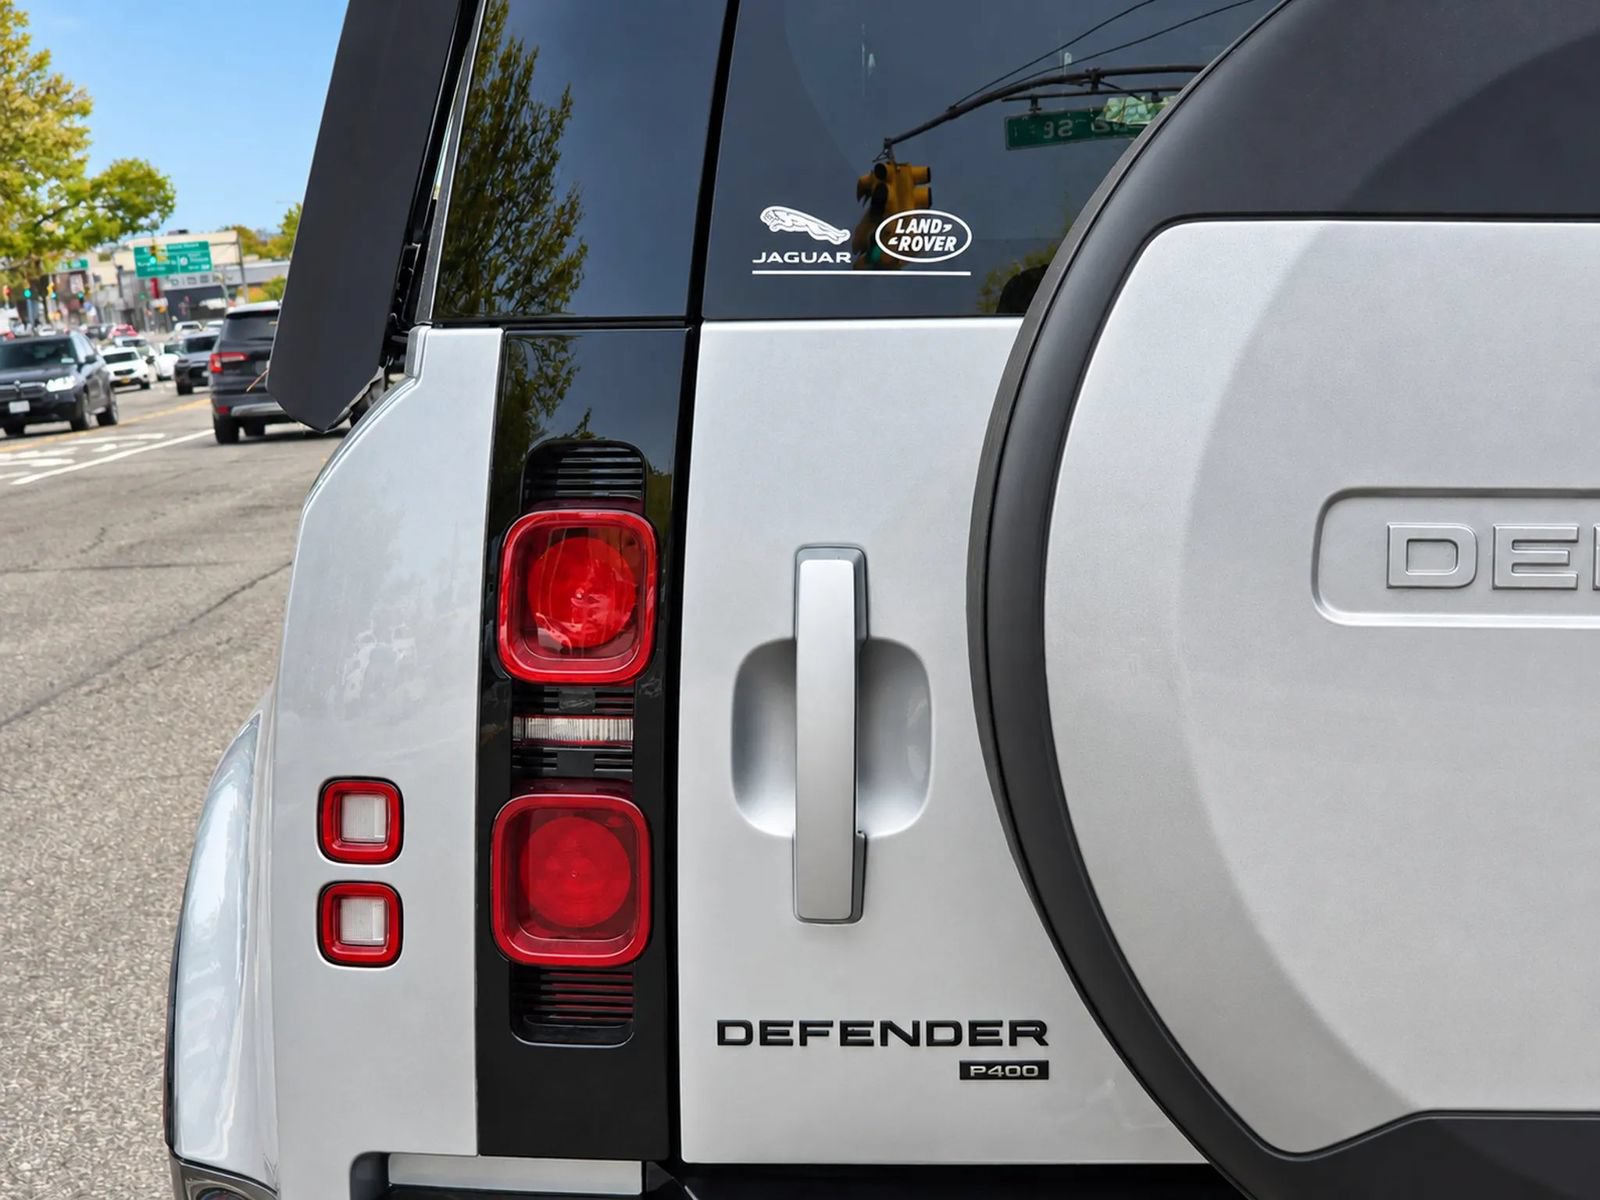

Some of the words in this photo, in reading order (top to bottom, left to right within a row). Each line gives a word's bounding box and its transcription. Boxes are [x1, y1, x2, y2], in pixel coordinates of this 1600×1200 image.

[895, 218, 943, 234] LAND
[898, 236, 957, 252] ROVER
[752, 251, 852, 264] JAGUAR
[1386, 522, 1600, 590] DE
[717, 1019, 1049, 1047] DEFENDER
[969, 1064, 1039, 1078] P400
